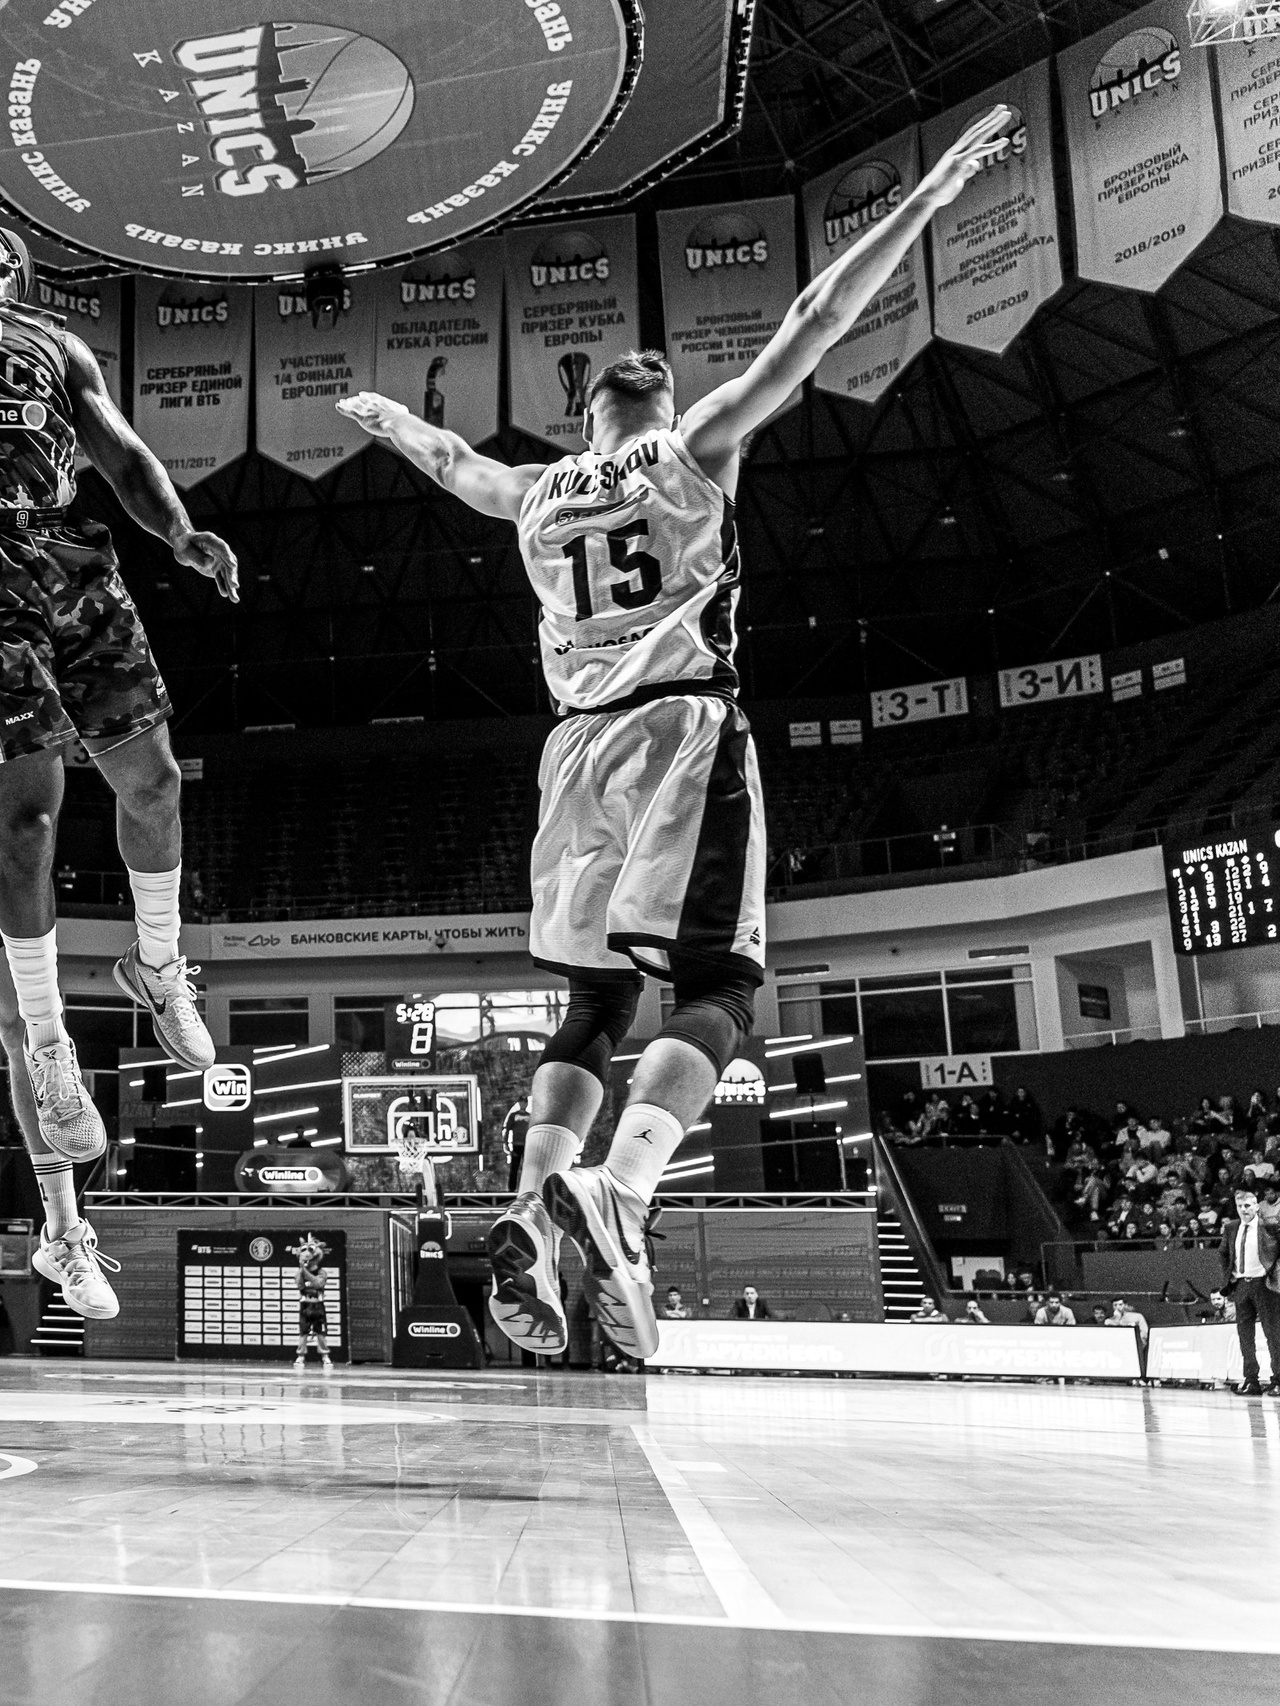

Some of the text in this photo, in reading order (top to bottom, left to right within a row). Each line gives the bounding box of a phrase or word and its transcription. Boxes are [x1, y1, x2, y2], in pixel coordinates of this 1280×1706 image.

[1089, 50, 1181, 118] UNICS
[175, 25, 300, 198] UNICS
[1097, 151, 1190, 202] ПРИЗЕР КУБКА
[1117, 173, 1171, 204] ЕВРОПЫ
[824, 184, 902, 246] UNICS
[1114, 223, 1187, 264] 2018/2019
[685, 240, 768, 269] UNICS
[531, 257, 610, 287] UNICS
[39, 282, 101, 319] UNICS
[401, 277, 477, 303] UNICS
[158, 302, 229, 327] UNICS
[523, 297, 617, 319] СЕРЕБРЯНЫЙ
[392, 318, 481, 335] ОБЛАДАТЕЛЬ
[521, 312, 626, 334] ПРИЗЕР КУБКА
[387, 333, 489, 350] КУБКА РОССИИ
[544, 329, 603, 348] ЕВРОПЫ
[146, 361, 232, 381] СЕРЕБРЯНЫЙ
[280, 353, 346, 370] УЧАСТНИК
[140, 375, 243, 396] ПРИЗЕР ЕДИНОЙ
[274, 367, 353, 386] 1/4 ФИНАЛА
[159, 393, 221, 410] ЛИГИ ВТБ
[281, 382, 349, 400] ЕВРОЛИГИ
[286, 446, 345, 462] 2011/2012
[16, 511, 29, 528] 9
[561, 518, 663, 622] 15
[5, 711, 35, 726] MAXX
[1183, 839, 1248, 864] UNICS KAZAN
[290, 931, 379, 945] БАНКОВСКИЕ
[382, 928, 433, 943] КАРТЫ,
[434, 926, 482, 941] ЧТОБЫ
[485, 925, 526, 938] ЖИТЬ
[396, 1003, 435, 1022] 5:28
[410, 1023, 433, 1054] 8
[214, 1079, 247, 1096] Win
[262, 1170, 304, 1180] Winline
[412, 1325, 446, 1334] Winline
